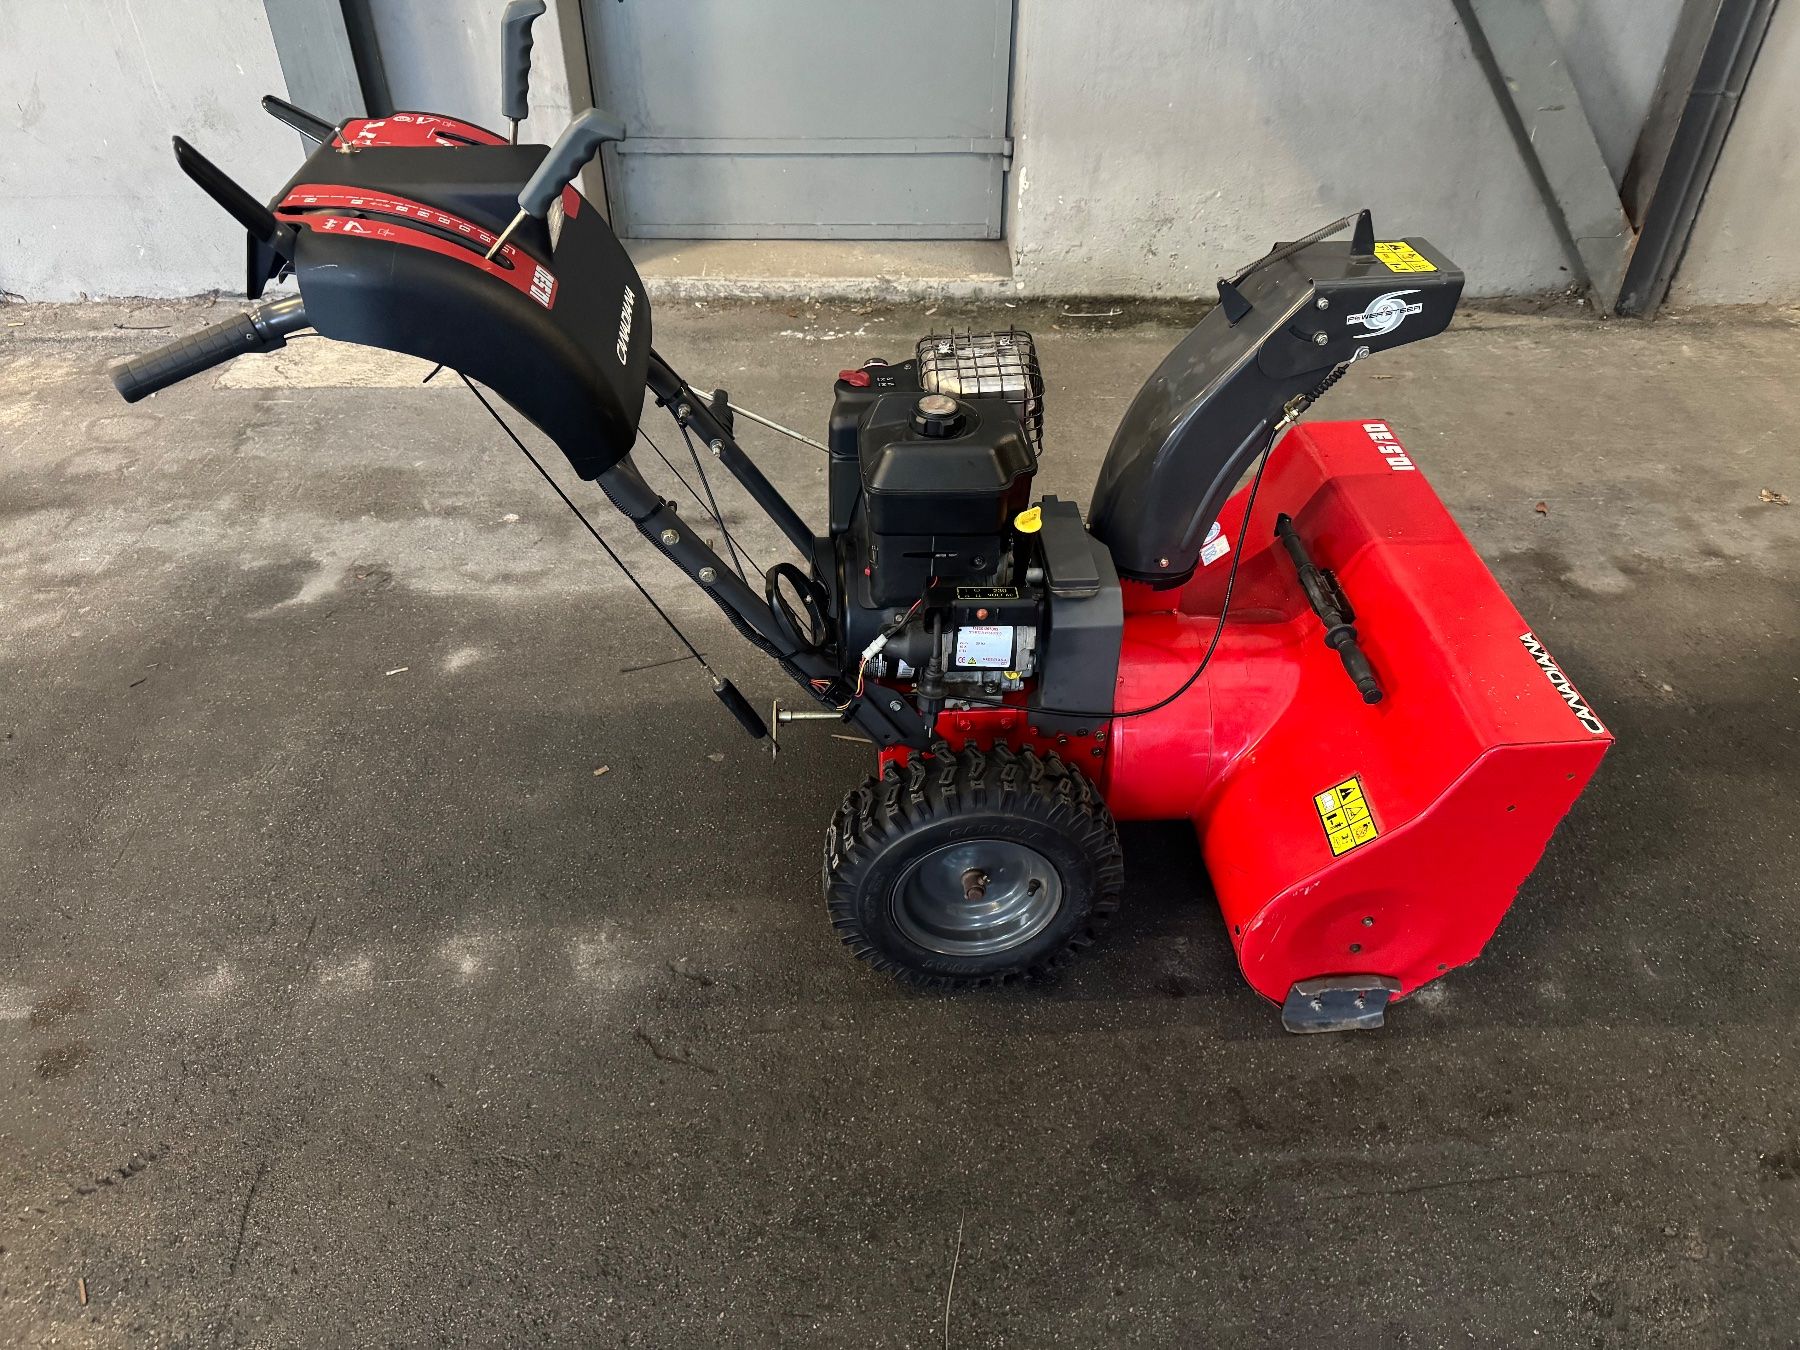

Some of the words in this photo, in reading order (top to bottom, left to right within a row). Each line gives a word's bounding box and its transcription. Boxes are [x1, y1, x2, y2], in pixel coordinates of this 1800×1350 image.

[616, 285, 637, 367] CANADIANA
[1363, 423, 1415, 471] 10.5/30
[1519, 632, 1605, 735] CANADIANA
